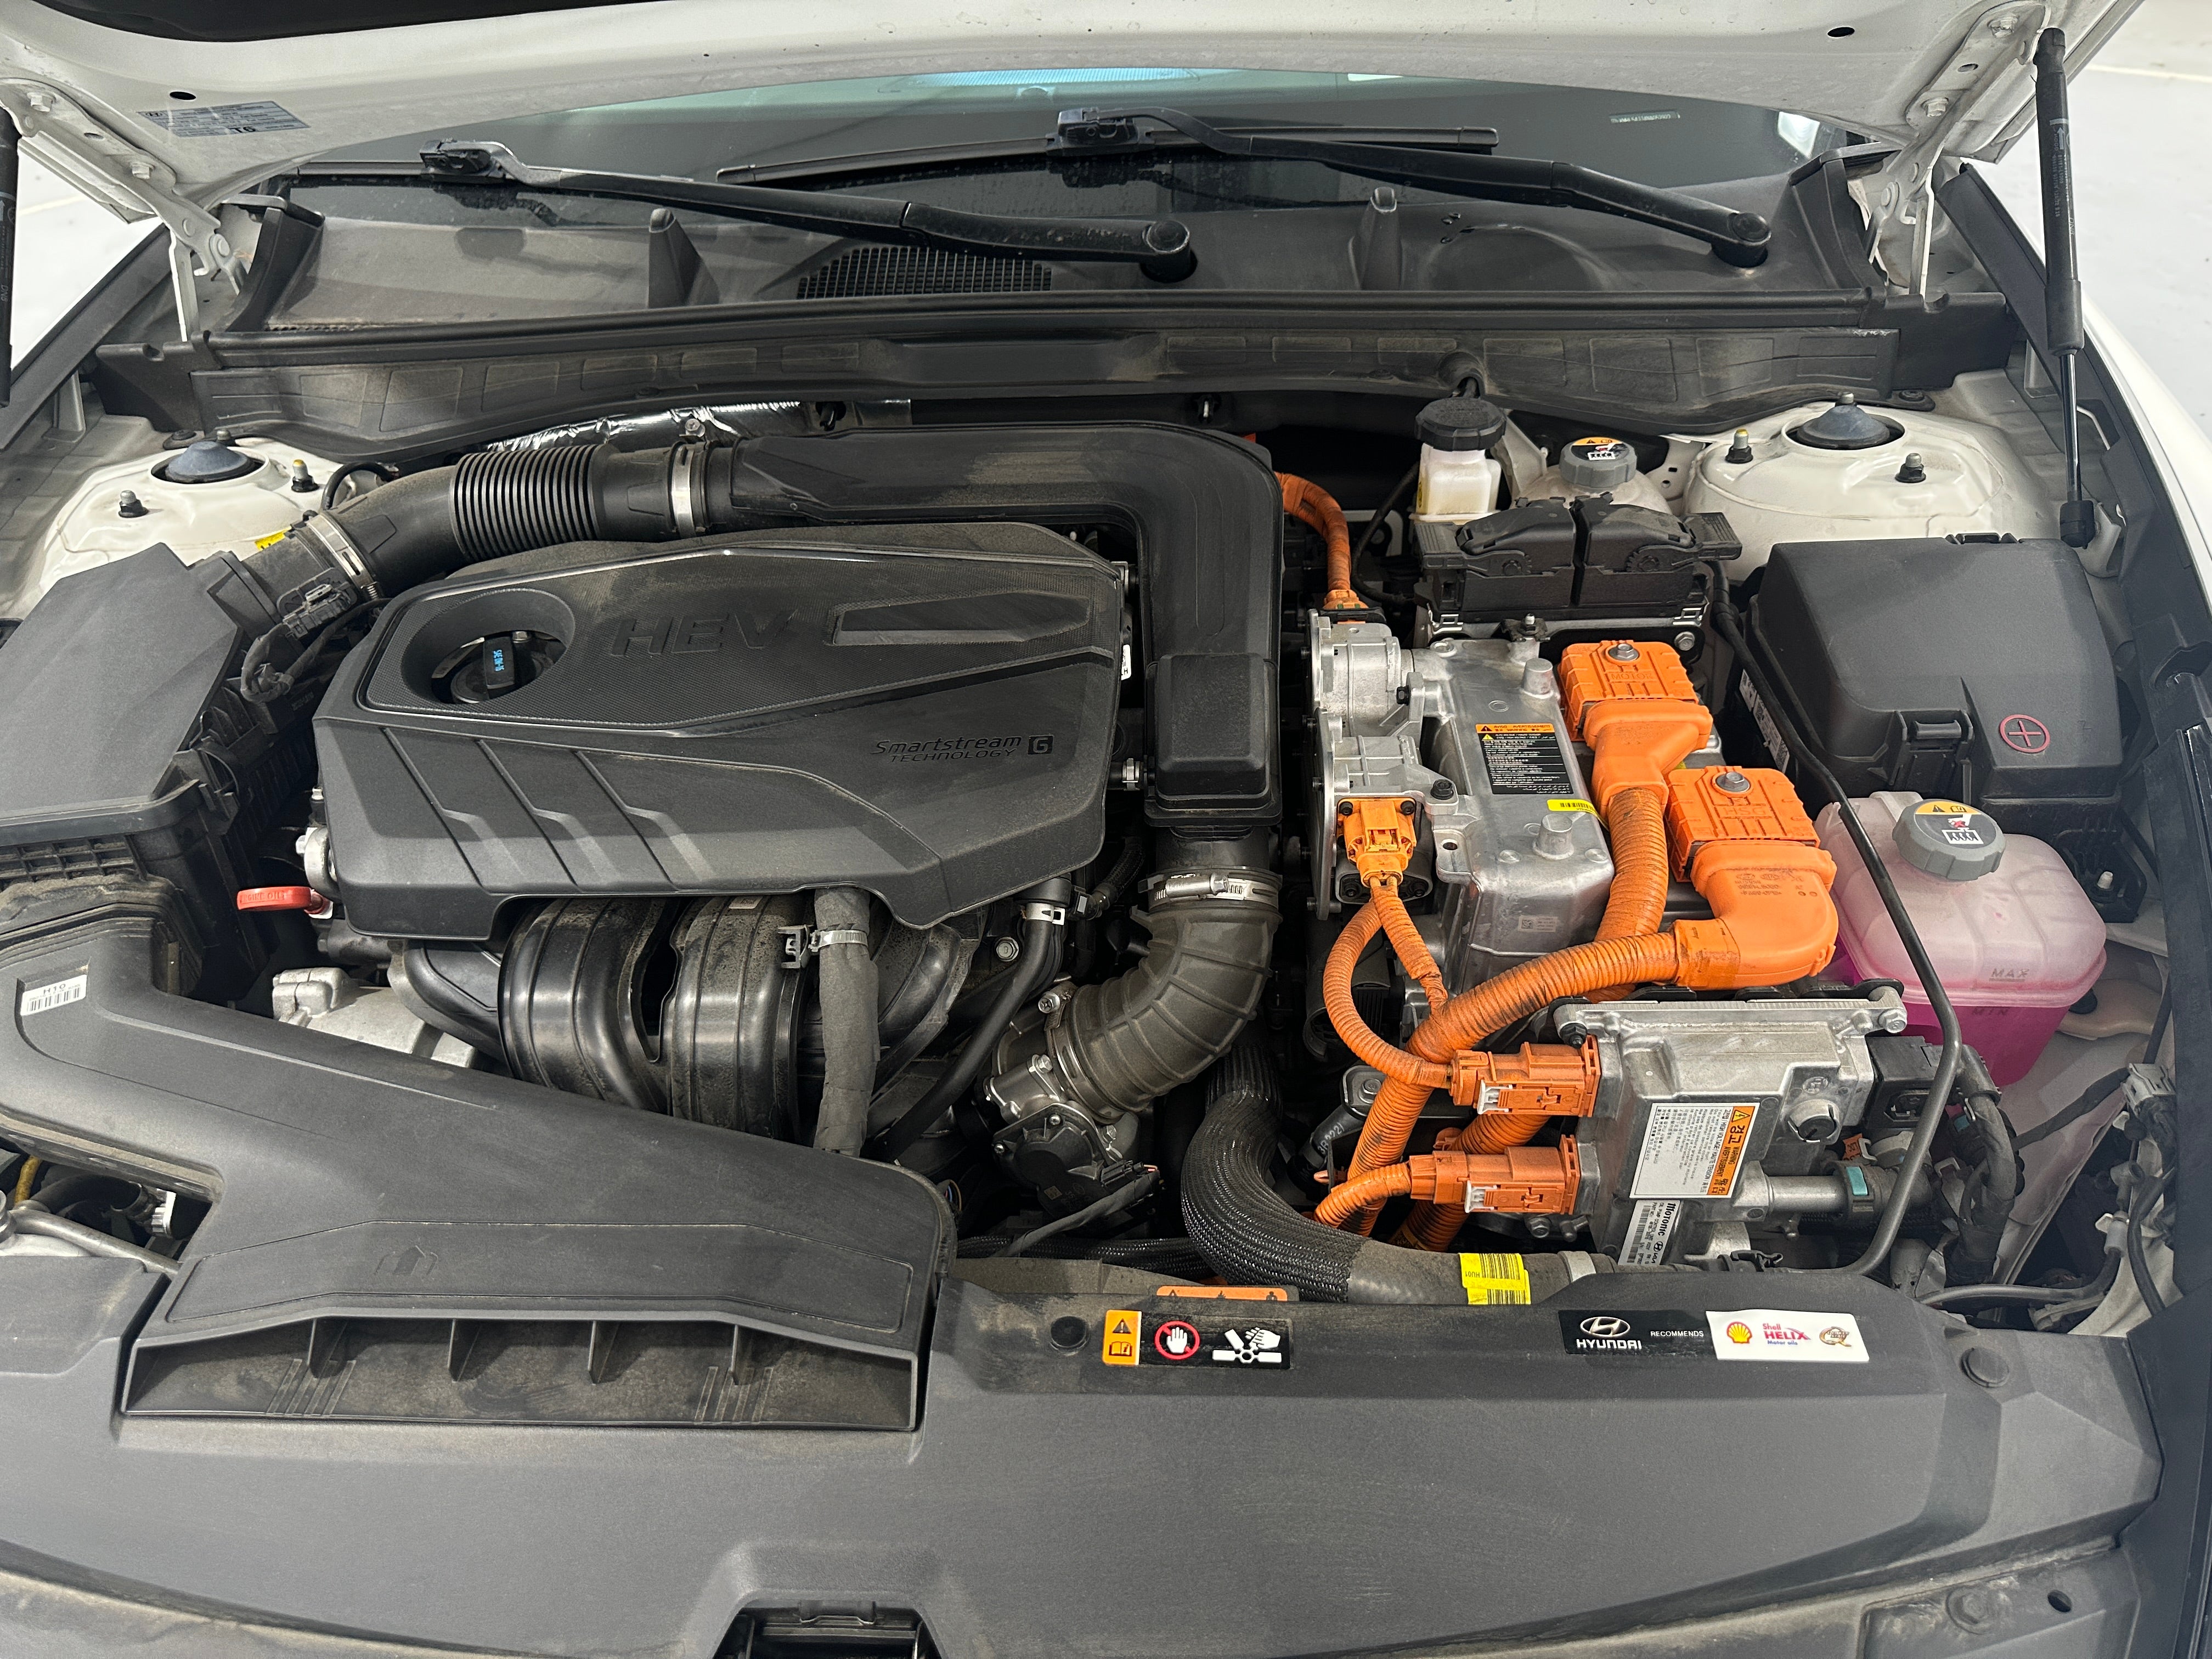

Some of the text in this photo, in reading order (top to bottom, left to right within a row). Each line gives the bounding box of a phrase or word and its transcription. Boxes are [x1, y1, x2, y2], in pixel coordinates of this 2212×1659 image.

[610, 611, 795, 657] HEV
[493, 650, 503, 658] SAE
[871, 736, 1022, 754] Smartstream
[890, 748, 1016, 763] TECHNOLOGY
[1724, 806, 1766, 815] HSG
[1991, 968, 2029, 978] MAX
[43, 983, 66, 994] H10
[1725, 1125, 1746, 1144] 경고
[1727, 1146, 1740, 1164] WARNING
[1657, 1203, 1677, 1235] MOTONIC
[1763, 1330, 1809, 1340] HELIX
[1576, 1339, 1643, 1350] HYUNDAI
